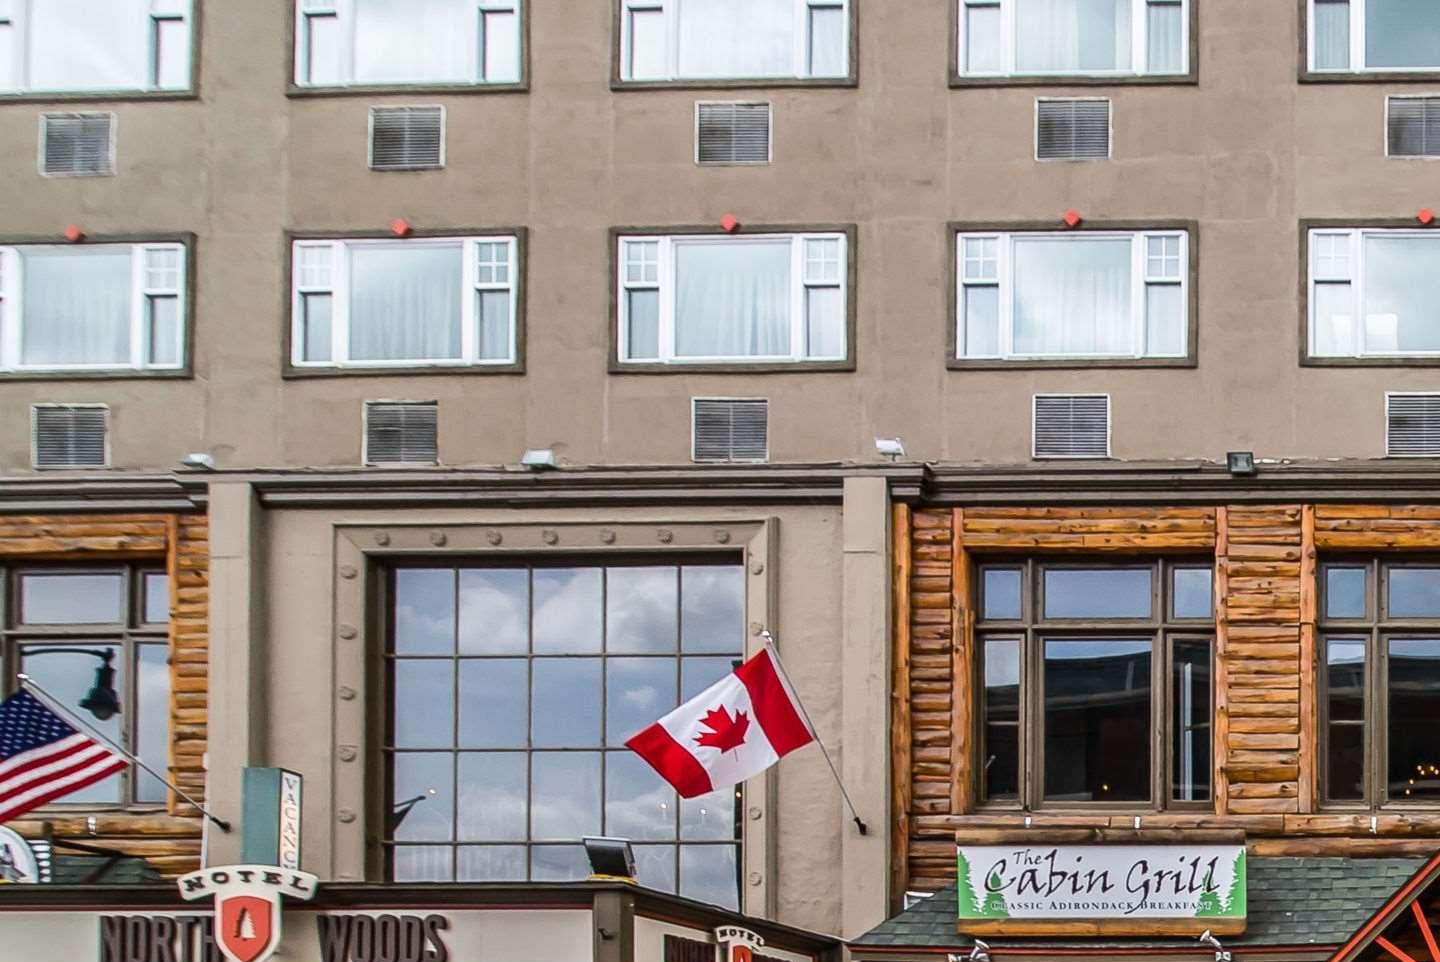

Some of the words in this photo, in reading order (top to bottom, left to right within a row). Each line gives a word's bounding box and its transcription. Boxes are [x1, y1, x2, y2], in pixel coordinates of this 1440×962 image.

[284, 776, 299, 870] VACANC
[1012, 851, 1044, 866] The
[183, 870, 310, 893] HOTEL
[984, 849, 1114, 898] Cabin
[1125, 855, 1221, 914] Grill
[1049, 901, 1134, 910] ADIRONDACK
[719, 928, 764, 946] HOTEL
